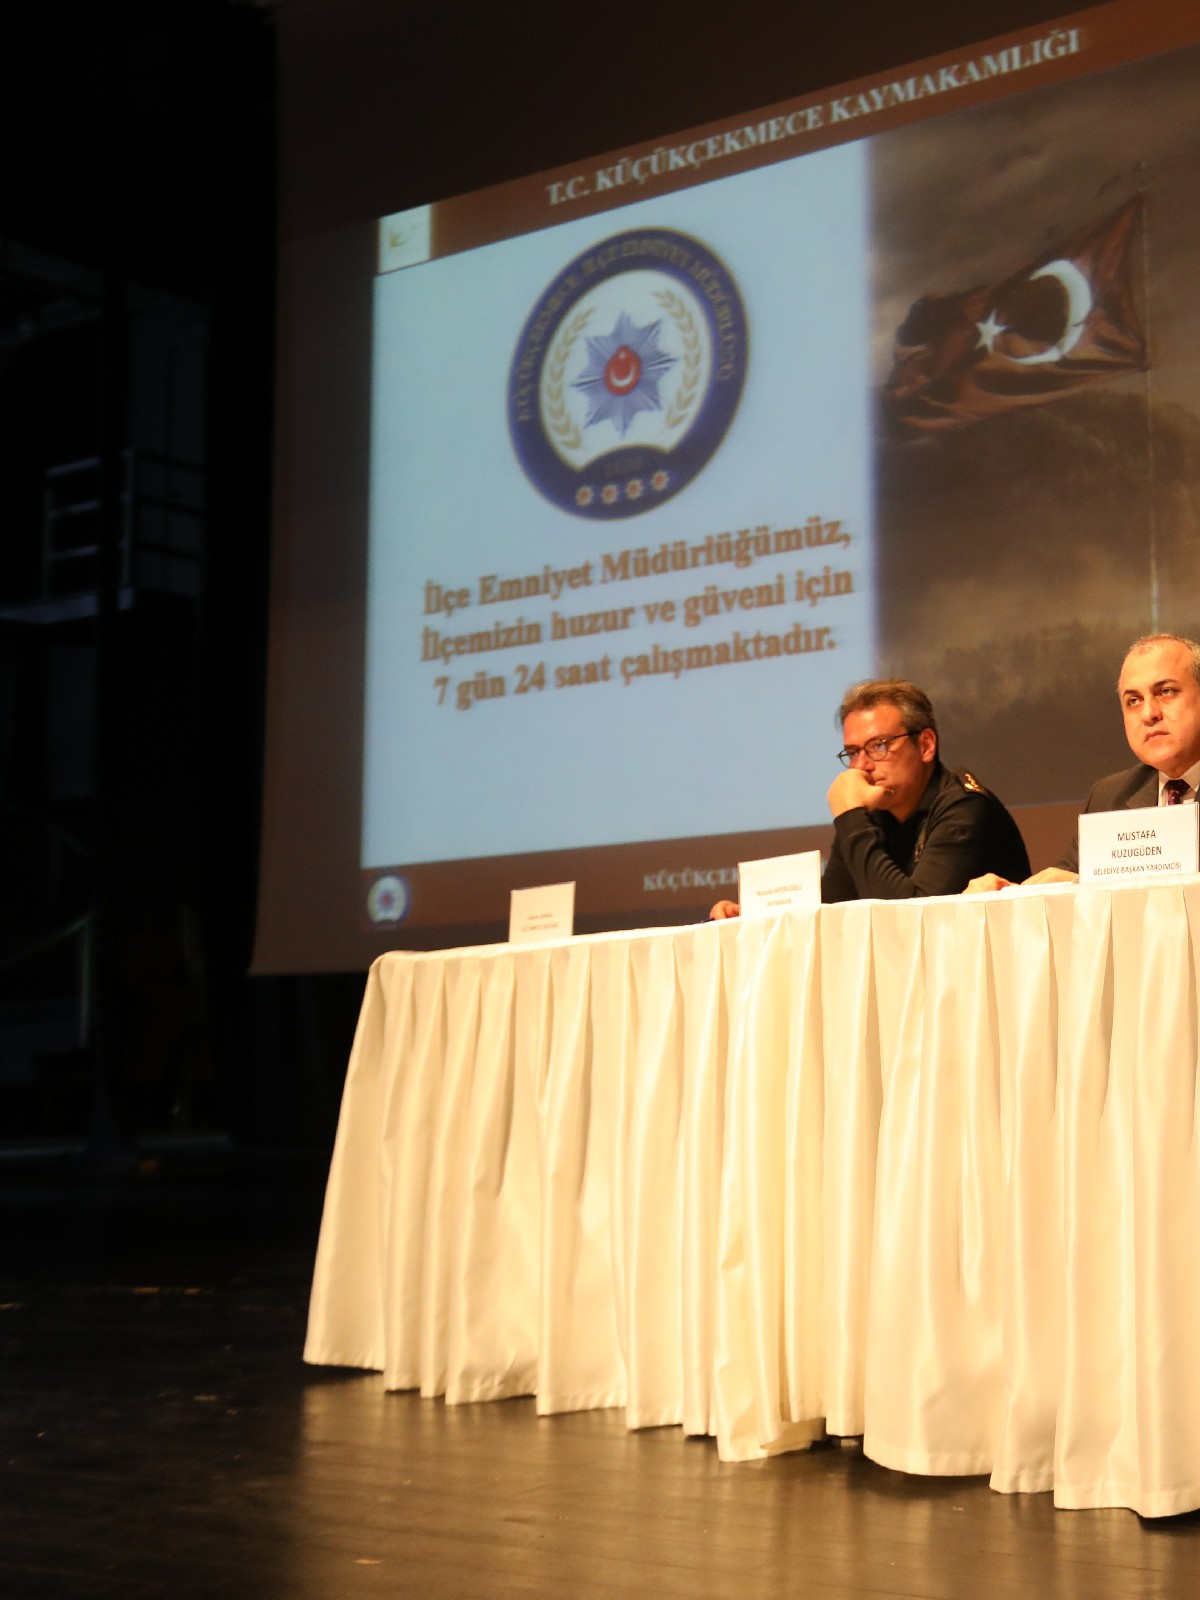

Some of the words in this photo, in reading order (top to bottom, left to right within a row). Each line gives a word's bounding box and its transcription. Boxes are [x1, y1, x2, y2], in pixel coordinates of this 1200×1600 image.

[546, 177, 590, 205] T.C.
[594, 104, 825, 193] KÜÇÜKÇEKMECE
[829, 28, 1081, 123] KAYMAKAMLIĞI
[424, 579, 471, 619] İlçe
[479, 560, 592, 605] Emniyet
[600, 516, 851, 584] Müdürlüğümüz,
[421, 617, 542, 665] İlçemizin
[552, 606, 635, 640] huzur
[643, 599, 676, 624] ve
[684, 573, 785, 627] güveni
[795, 565, 853, 607] için
[434, 676, 449, 706] 7
[456, 671, 505, 711] gün
[515, 661, 546, 694] 24
[554, 655, 611, 688] saat
[620, 622, 836, 687] çalışmaktadır.
[1112, 845, 1162, 859] KUZUGÜDEN
[1117, 830, 1156, 841] MUSTAFA
[1120, 864, 1145, 874] BAŞKAN
